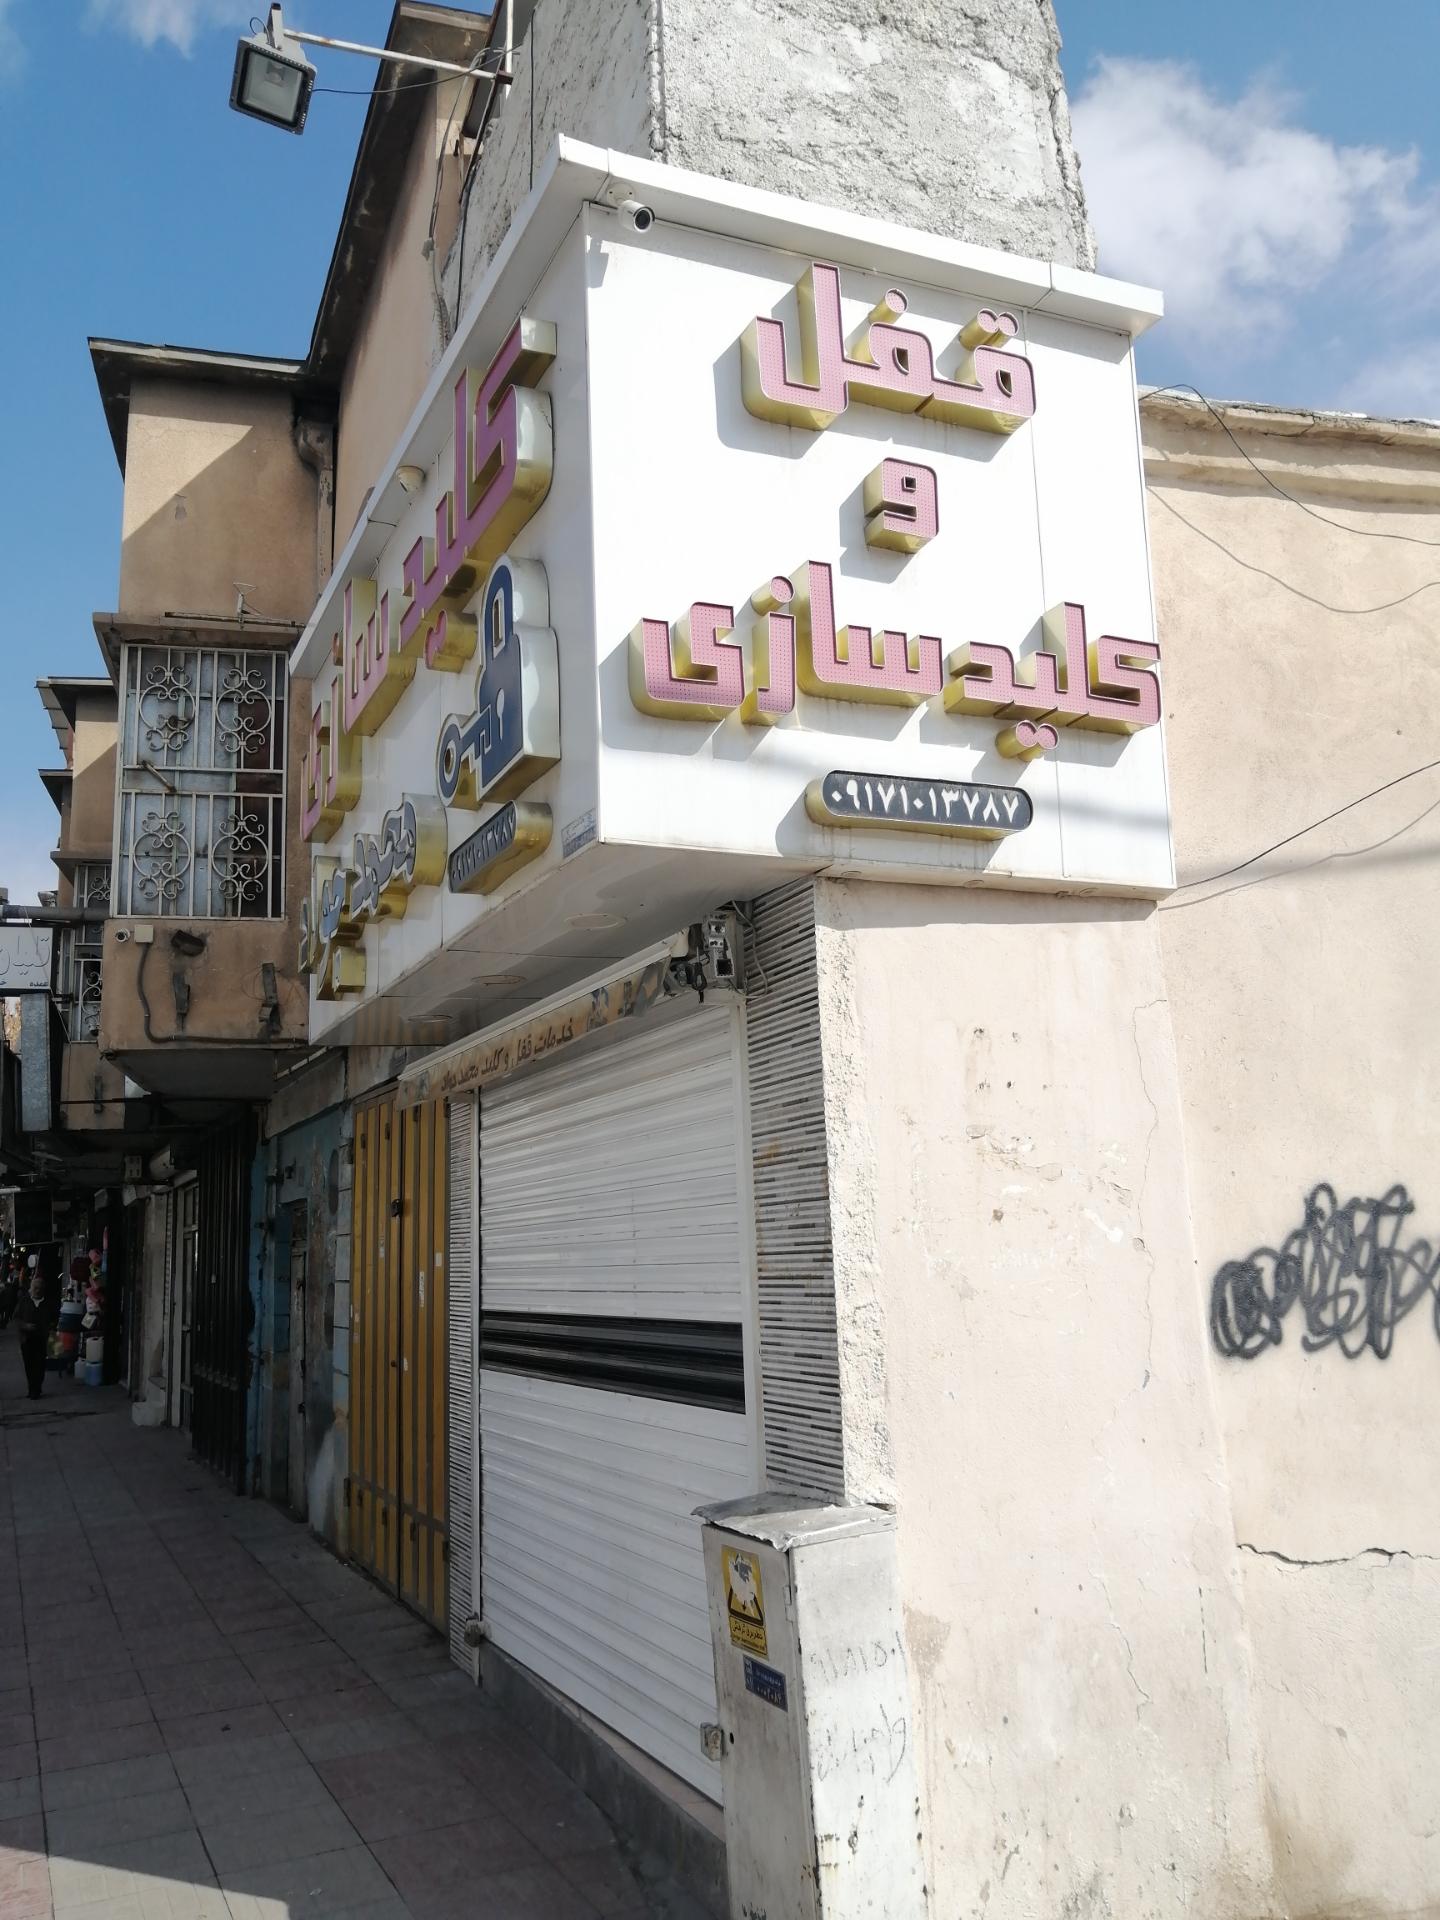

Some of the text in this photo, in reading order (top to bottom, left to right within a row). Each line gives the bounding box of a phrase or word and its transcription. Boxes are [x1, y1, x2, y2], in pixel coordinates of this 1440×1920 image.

[752, 262, 1037, 424] قفل
[874, 458, 938, 543] و
[829, 778, 1022, 825] ۰۹۱۷۱۰۱۳۷۸۷
[512, 1033, 532, 1067] قفل
[534, 1017, 574, 1054] خدمات
[481, 1046, 504, 1075] کلید
